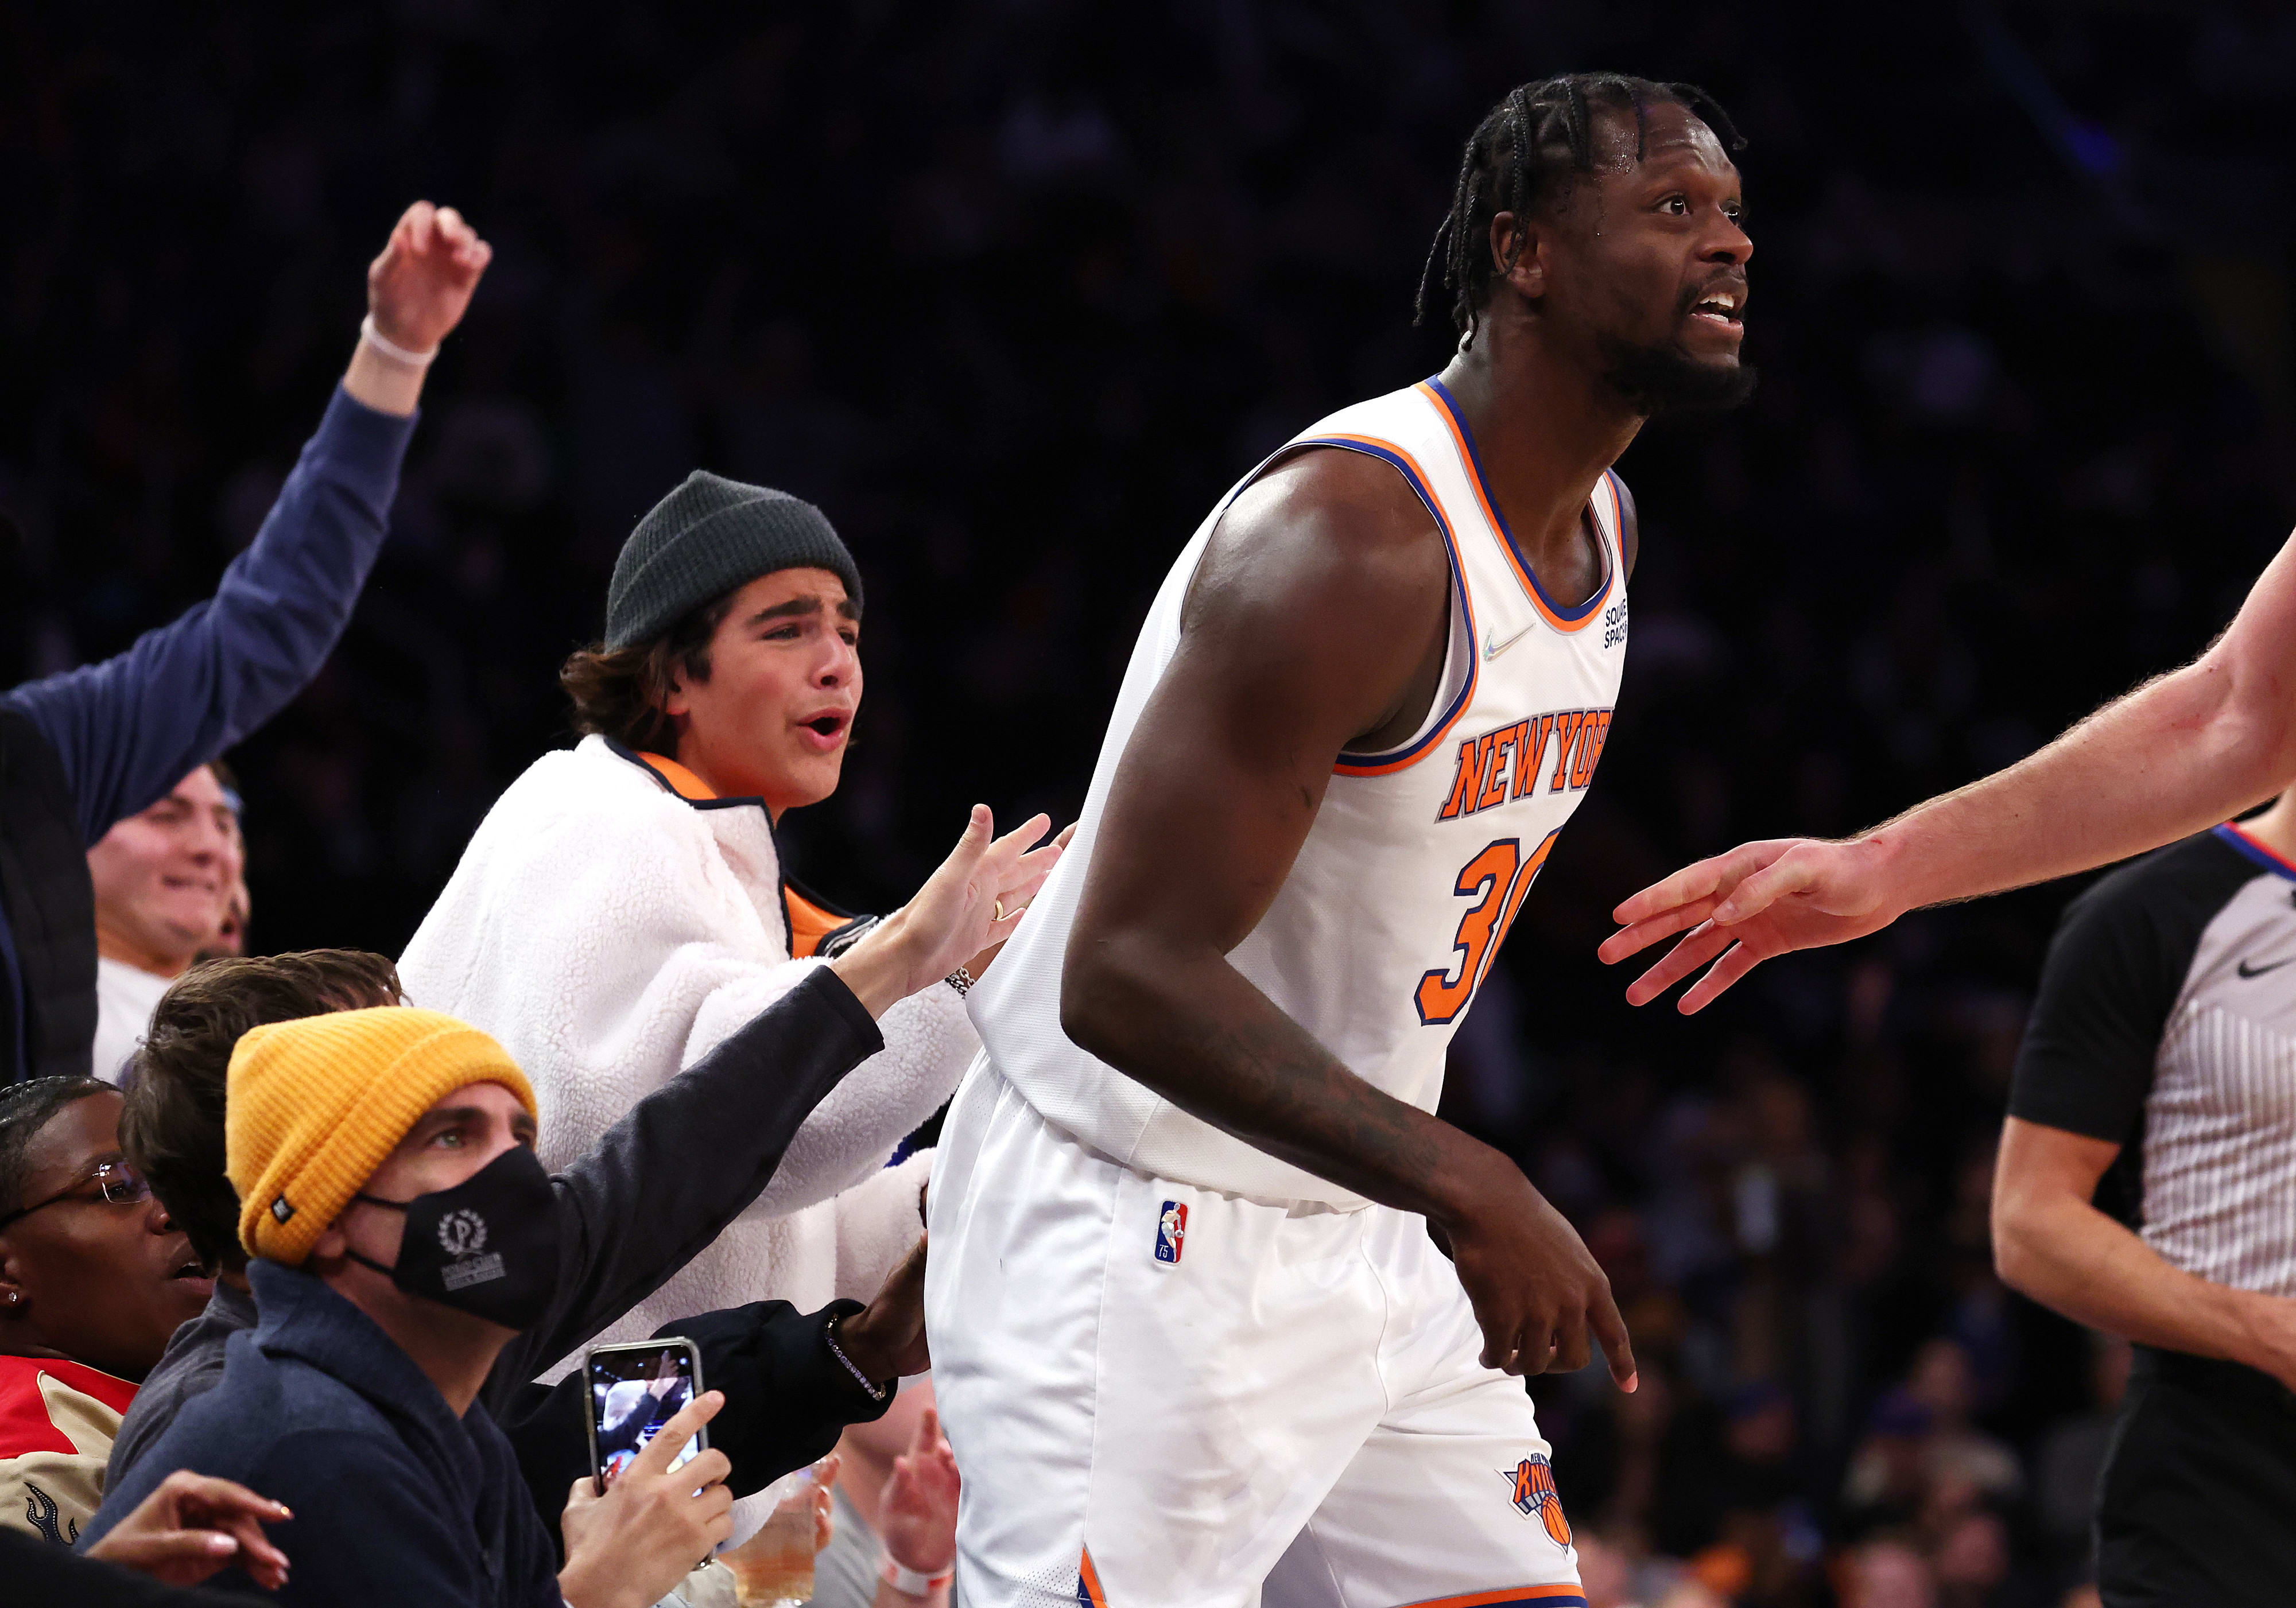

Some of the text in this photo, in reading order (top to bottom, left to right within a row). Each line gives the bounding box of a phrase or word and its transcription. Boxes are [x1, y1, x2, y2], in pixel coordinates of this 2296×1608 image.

[1605, 598, 1627, 627] SQUARE
[1604, 622, 1625, 649] SPACE
[1436, 707, 1615, 822] NEW YOR
[1159, 1244, 1169, 1259] 75
[1513, 1458, 1557, 1504] KNIC
